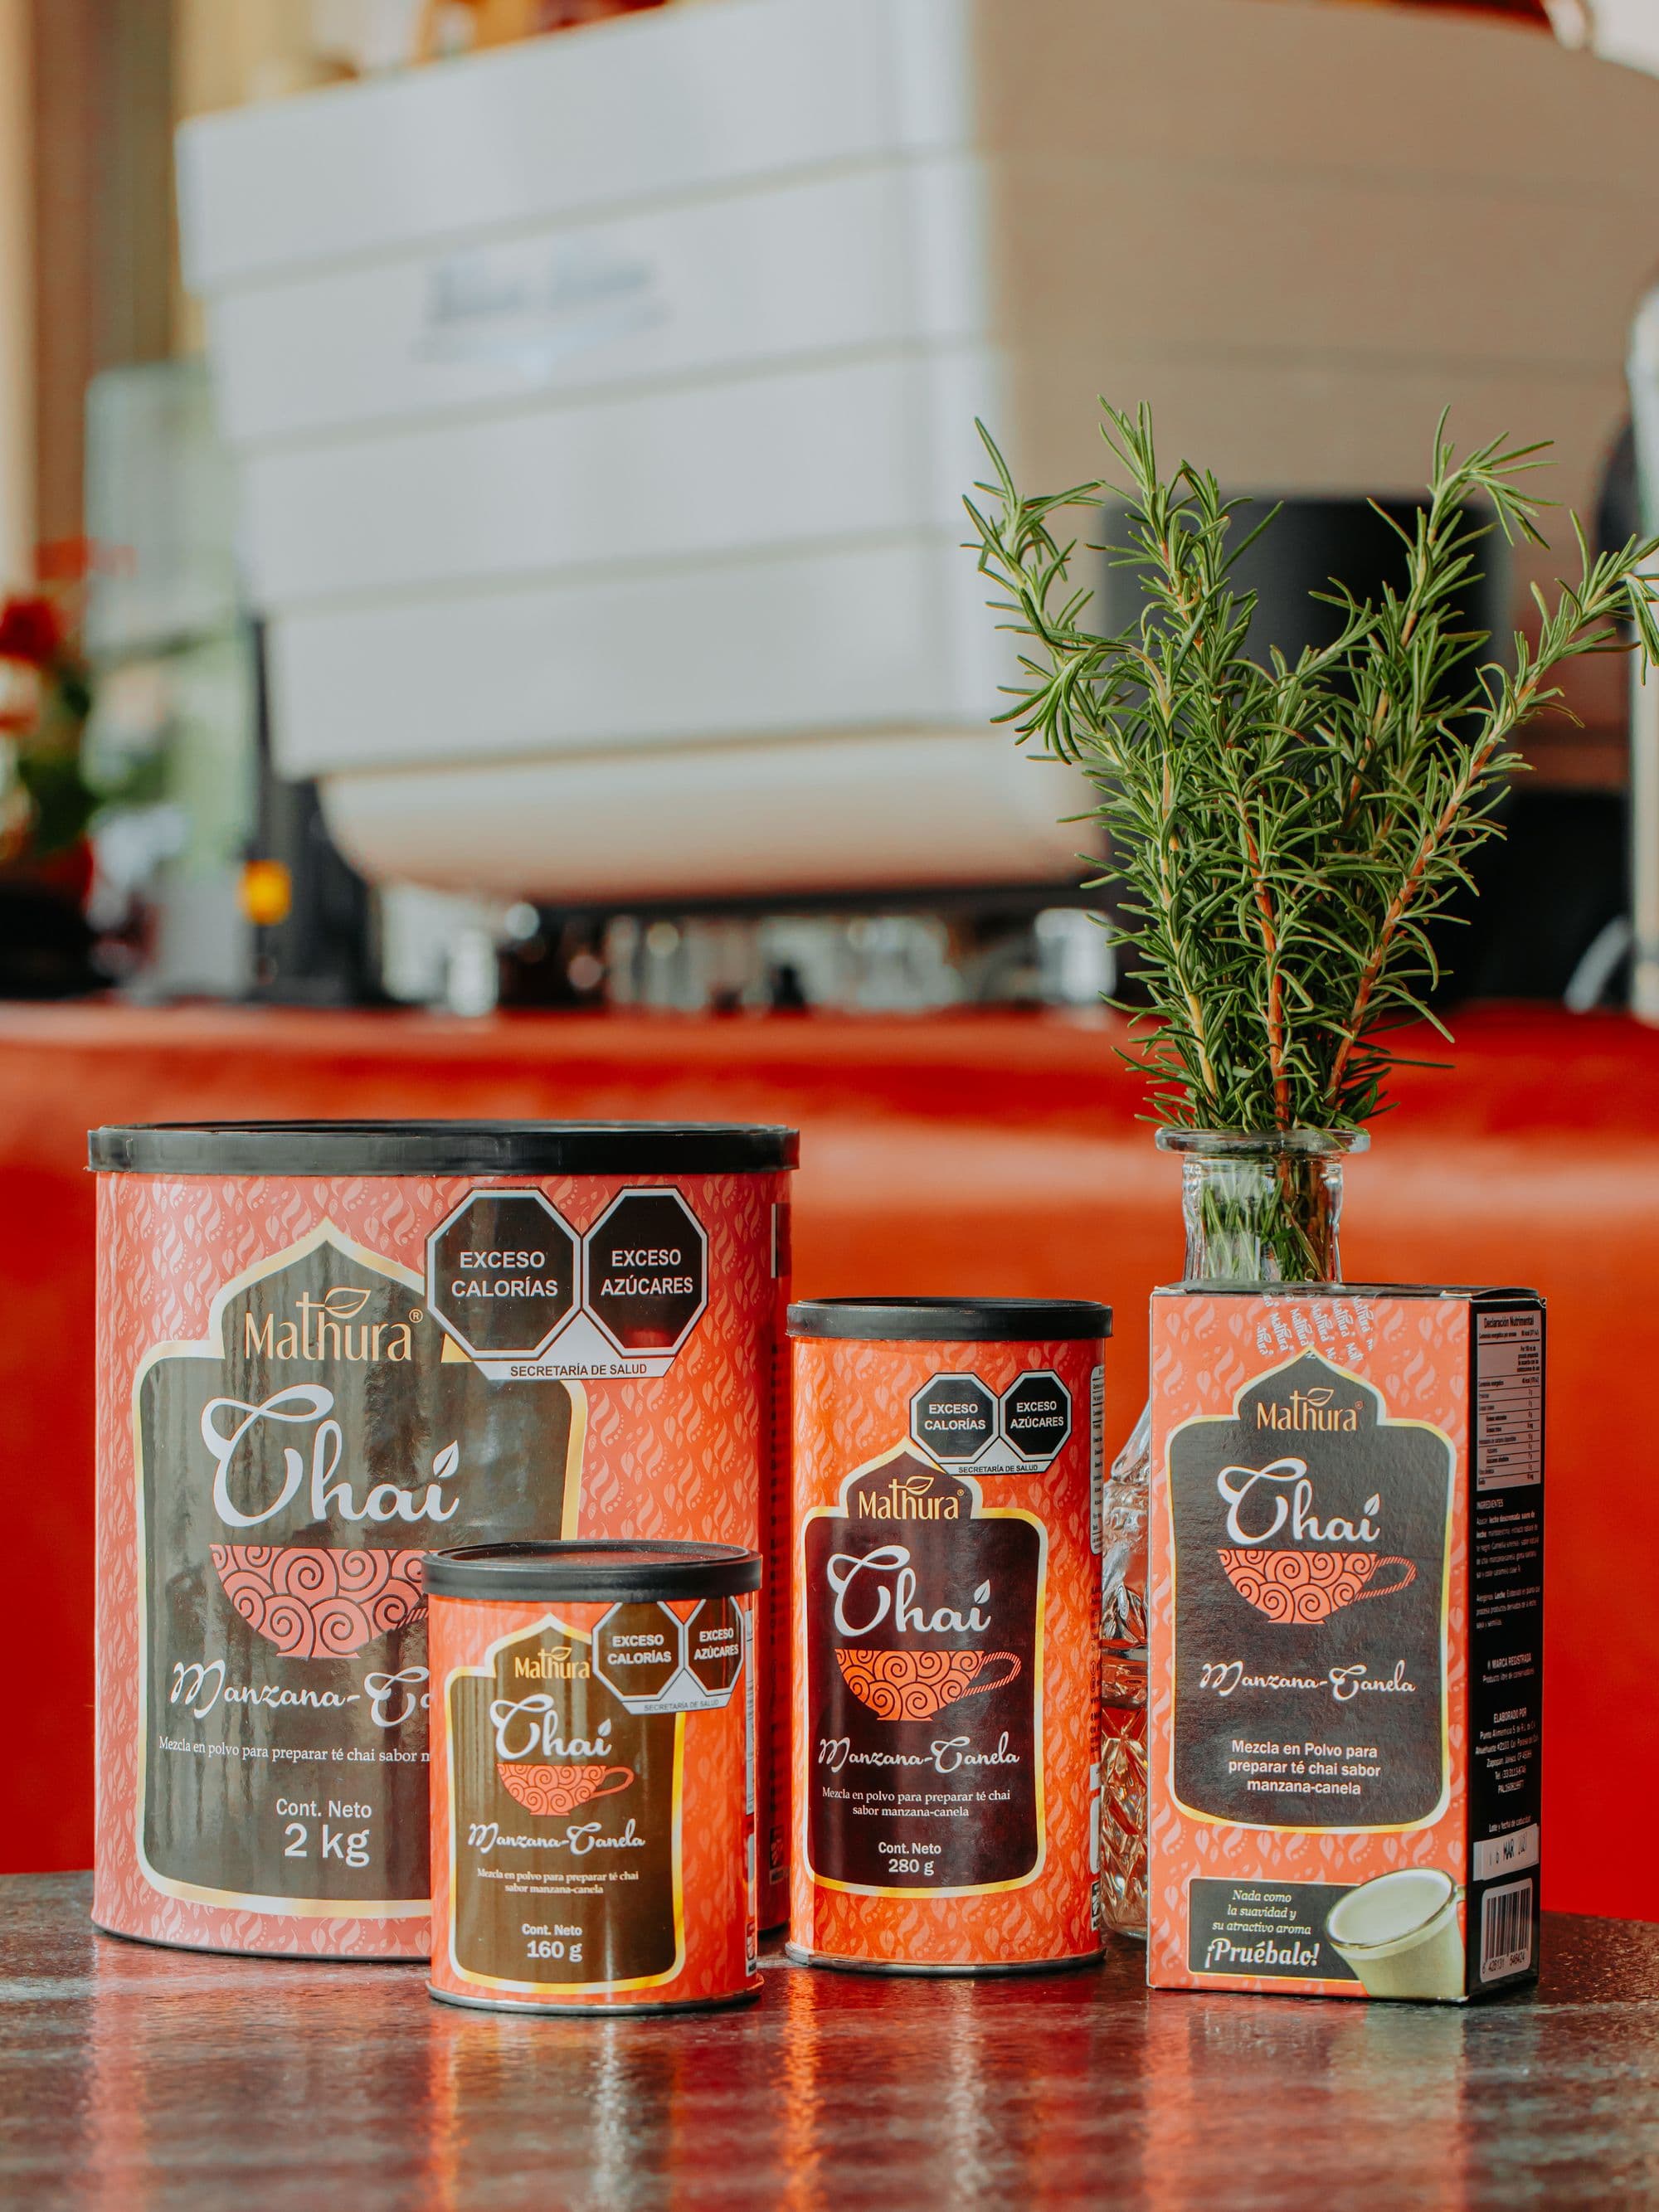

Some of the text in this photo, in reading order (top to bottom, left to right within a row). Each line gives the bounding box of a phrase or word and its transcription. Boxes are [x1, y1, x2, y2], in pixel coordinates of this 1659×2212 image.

[460, 1251, 545, 1269] EXCESO
[611, 1248, 682, 1267] EXCESO
[451, 1276, 558, 1298] CALORÍAS
[601, 1274, 693, 1296] AZÚCARES
[245, 1287, 412, 1361] Mathura
[510, 1363, 647, 1377] SECRETARÍA DE SALUD
[929, 1403, 979, 1414] EXCESO
[1016, 1401, 1057, 1412] EXCESO
[1257, 1388, 1357, 1432] Mathura
[924, 1418, 985, 1431] CALORÍAS
[1010, 1416, 1063, 1429] AZÚCARES
[201, 1383, 460, 1527] Chai
[958, 1465, 1005, 1473] SECRETARÍA
[859, 1476, 960, 1520] Mathura
[1217, 1457, 1380, 1544] Chai
[827, 1545, 991, 1637] Chai
[612, 1634, 664, 1648] EXCESO
[699, 1628, 733, 1642] EXCESO
[607, 1650, 671, 1665] CALORÍAS
[694, 1644, 738, 1660] AZÚCARES
[514, 1646, 591, 1679] Mathura
[1199, 1660, 1416, 1701] Manzana-Canela
[644, 1699, 719, 1712] SECRETARÍA DE SALUD
[489, 1694, 612, 1759] Chai
[159, 1736, 192, 1752] Mezcla
[193, 1743, 206, 1753] en
[208, 1742, 239, 1757] polvo
[242, 1747, 269, 1759] para
[272, 1748, 328, 1762] preparar
[331, 1748, 343, 1760] té
[347, 1748, 375, 1761] chai
[379, 1749, 416, 1762] sabor
[818, 1731, 1020, 1773] Manzana-Canela
[1232, 1740, 1378, 1760] Mezcla en Polvo para
[1228, 1761, 1381, 1777] preparar té chai sabor
[822, 1787, 1010, 1805] Mezcla en polvo para preparar té chai
[1247, 1780, 1362, 1795] manzana-canela
[276, 1798, 372, 1818] Cont. Neto
[852, 1805, 970, 1817] sabor manzana-canela
[285, 1823, 370, 1867] 2 kg
[468, 1818, 645, 1855] Manzana-Canela
[878, 1842, 941, 1855] Cont. Neto
[477, 1868, 504, 1879] Mezcla
[516, 1871, 542, 1882] polvo
[543, 1873, 564, 1884] para
[566, 1873, 606, 1884] preparar
[609, 1872, 618, 1881] té
[620, 1871, 639, 1880] chai
[888, 1859, 935, 1876] 280 g
[504, 1884, 604, 1894] sabor manzana-canela
[1232, 1889, 1292, 1903] Nada como
[1227, 1904, 1297, 1921] la suavidad y
[522, 1923, 582, 1936] Cont. Neto
[1212, 1922, 1312, 1935] su atractivo aroma
[527, 1941, 582, 1962] 160 g
[1204, 1937, 1321, 1969] ¡Pruébalo!
